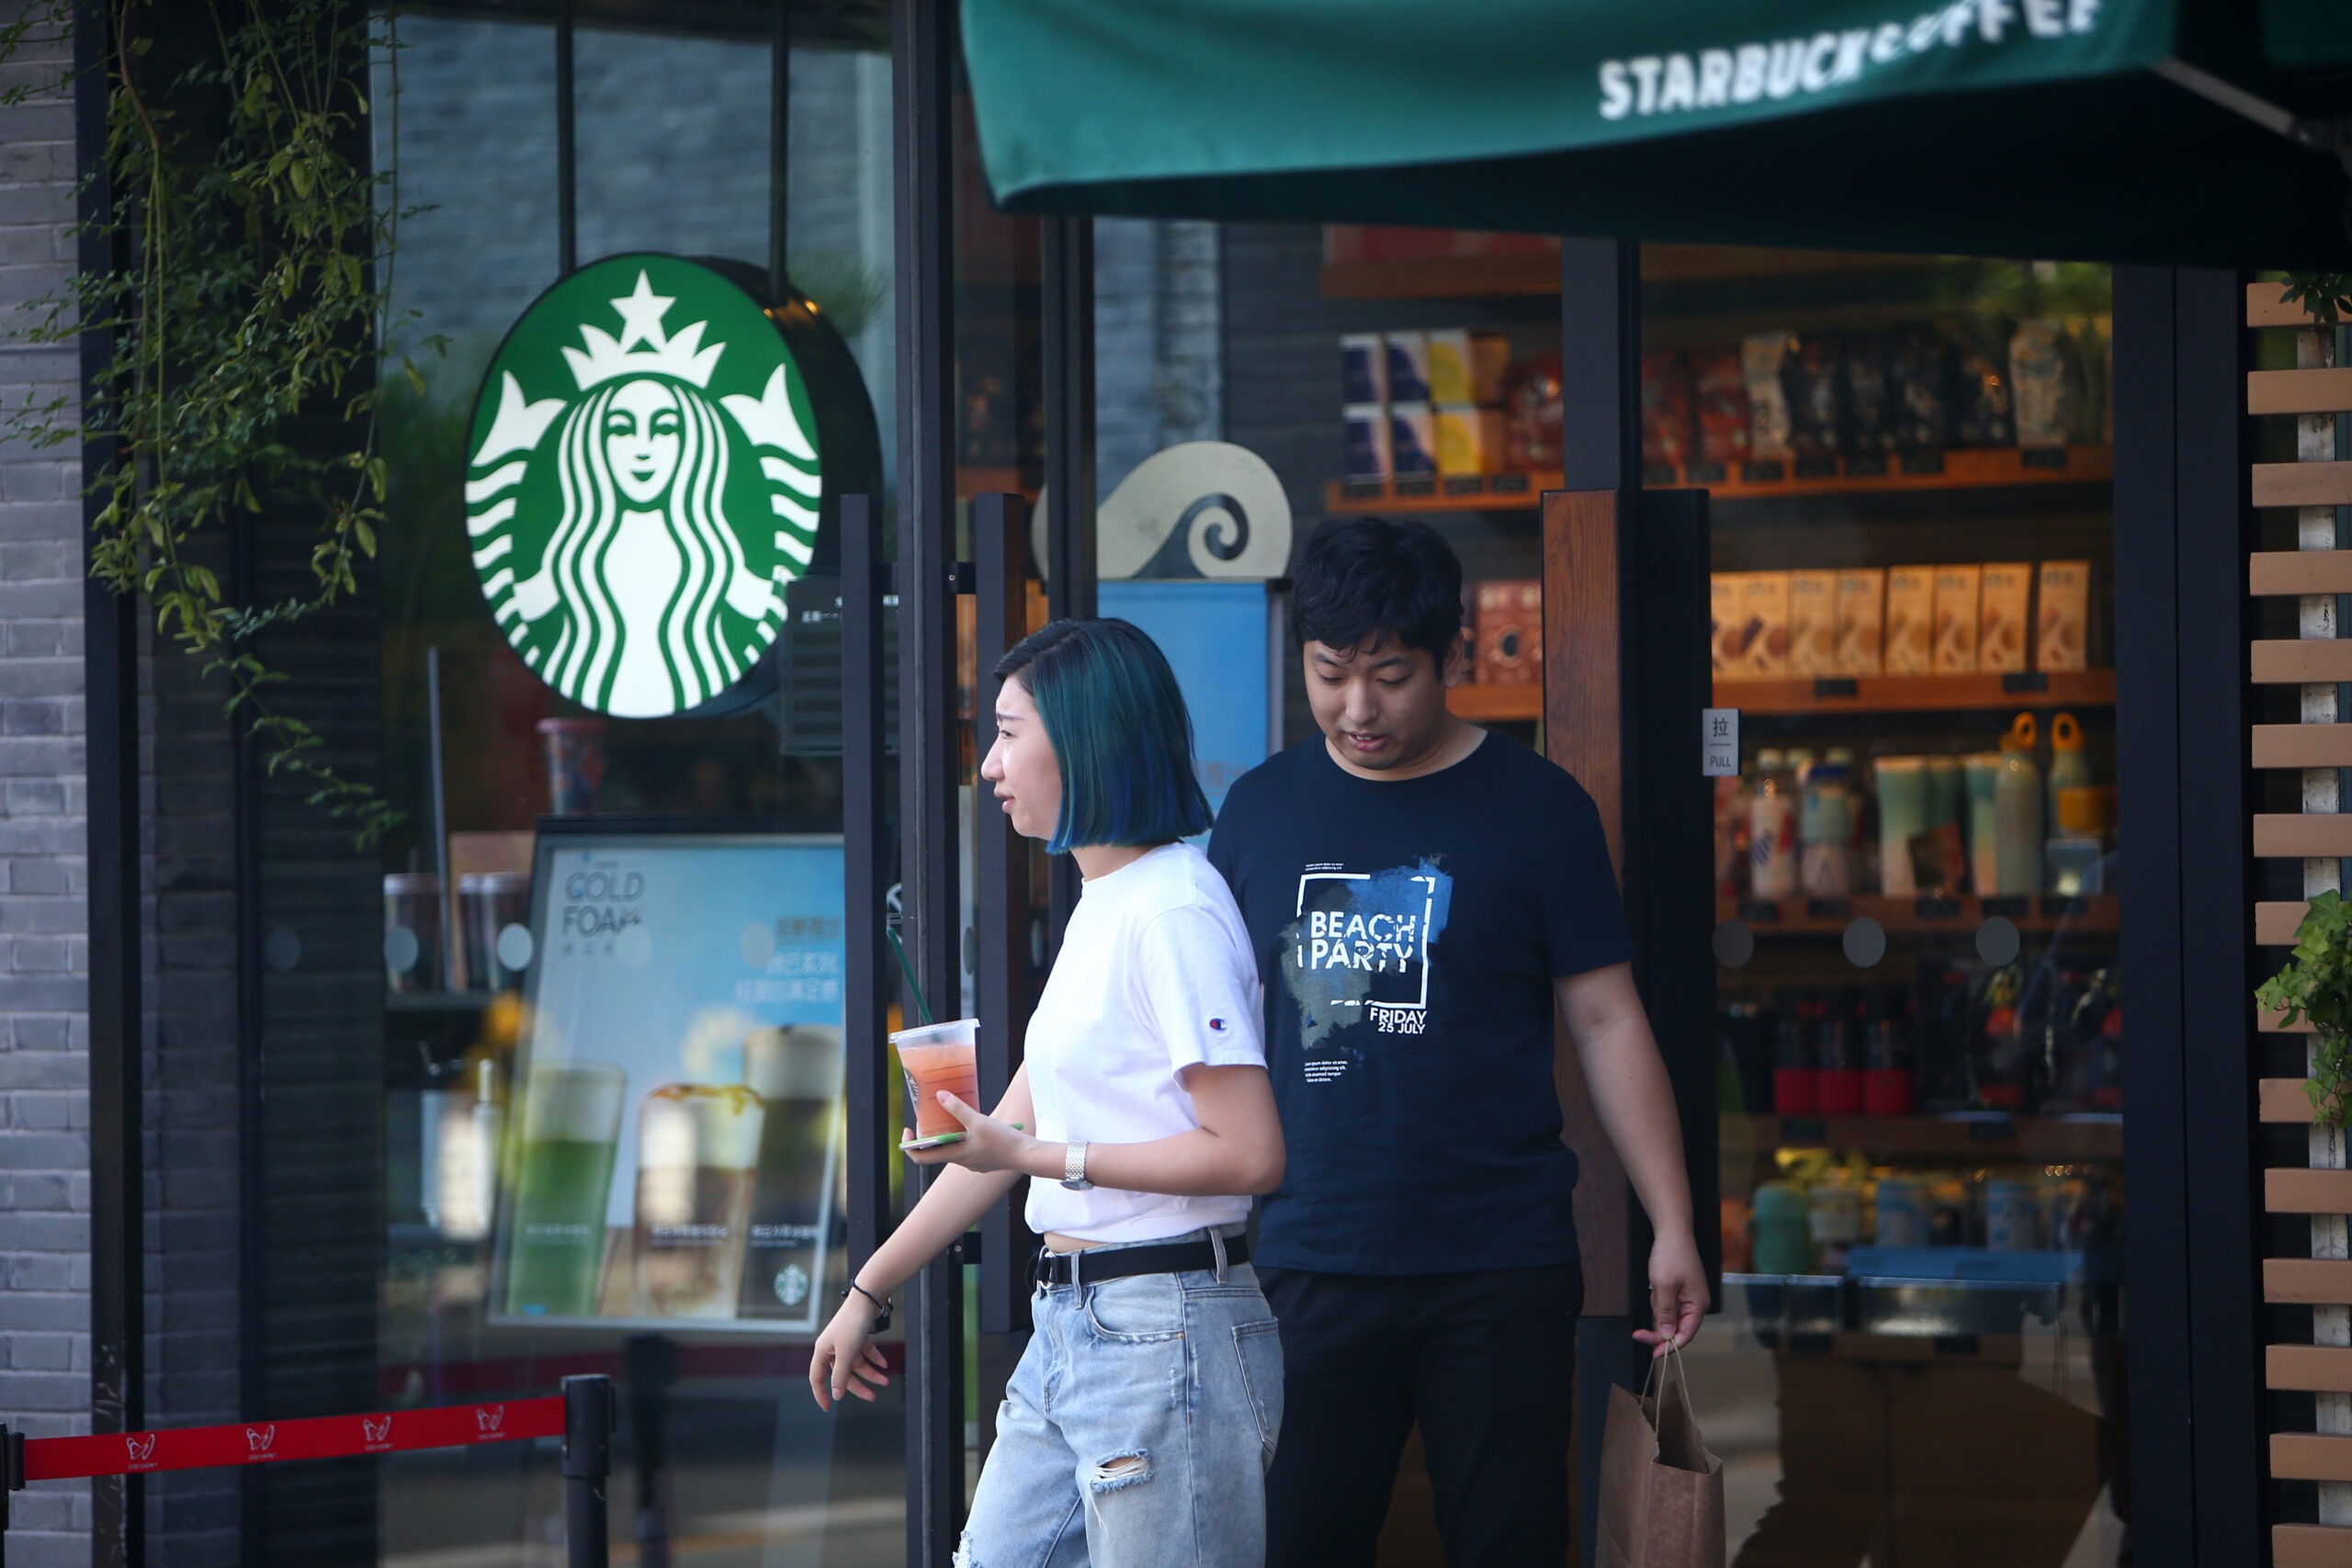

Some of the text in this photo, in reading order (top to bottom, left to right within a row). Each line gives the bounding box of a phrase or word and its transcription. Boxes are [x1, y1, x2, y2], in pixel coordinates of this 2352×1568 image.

[1599, 28, 1869, 120] STARBUCK
[1713, 717, 1729, 737] 拉
[1710, 755, 1731, 767] PULL
[565, 871, 646, 903] COLD
[1311, 910, 1416, 942] BEACH
[1311, 939, 1414, 973] PARTY
[1370, 1007, 1427, 1025] FRIDAY
[1378, 1021, 1426, 1034] 25 JULY
